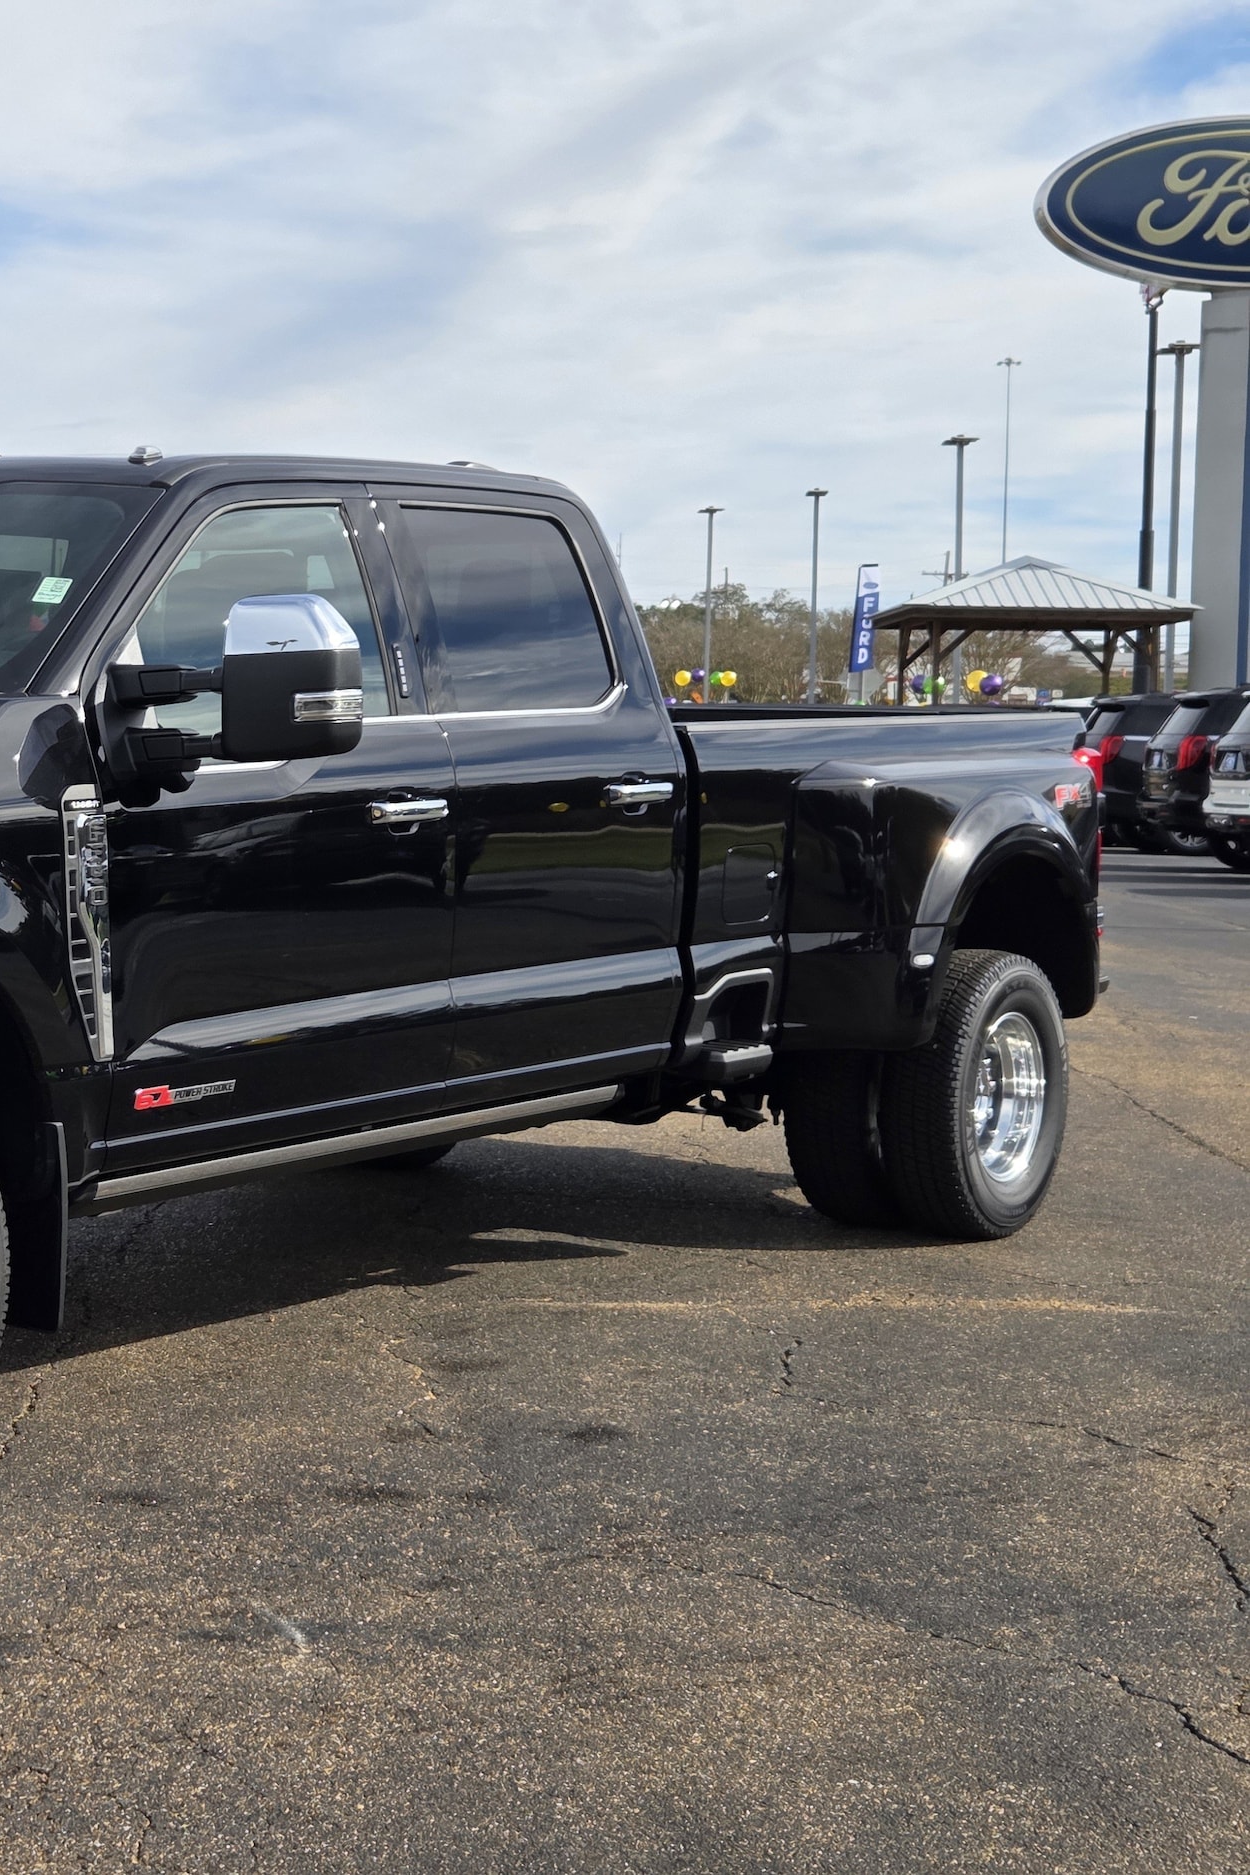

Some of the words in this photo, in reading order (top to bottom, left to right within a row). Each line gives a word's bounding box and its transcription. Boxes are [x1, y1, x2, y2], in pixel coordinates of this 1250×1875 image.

[1136, 149, 1250, 246] Fo
[857, 597, 875, 664] FORD
[1054, 783, 1091, 809] FX4
[174, 1088, 201, 1100] POWER
[202, 1081, 235, 1095] STROKE
